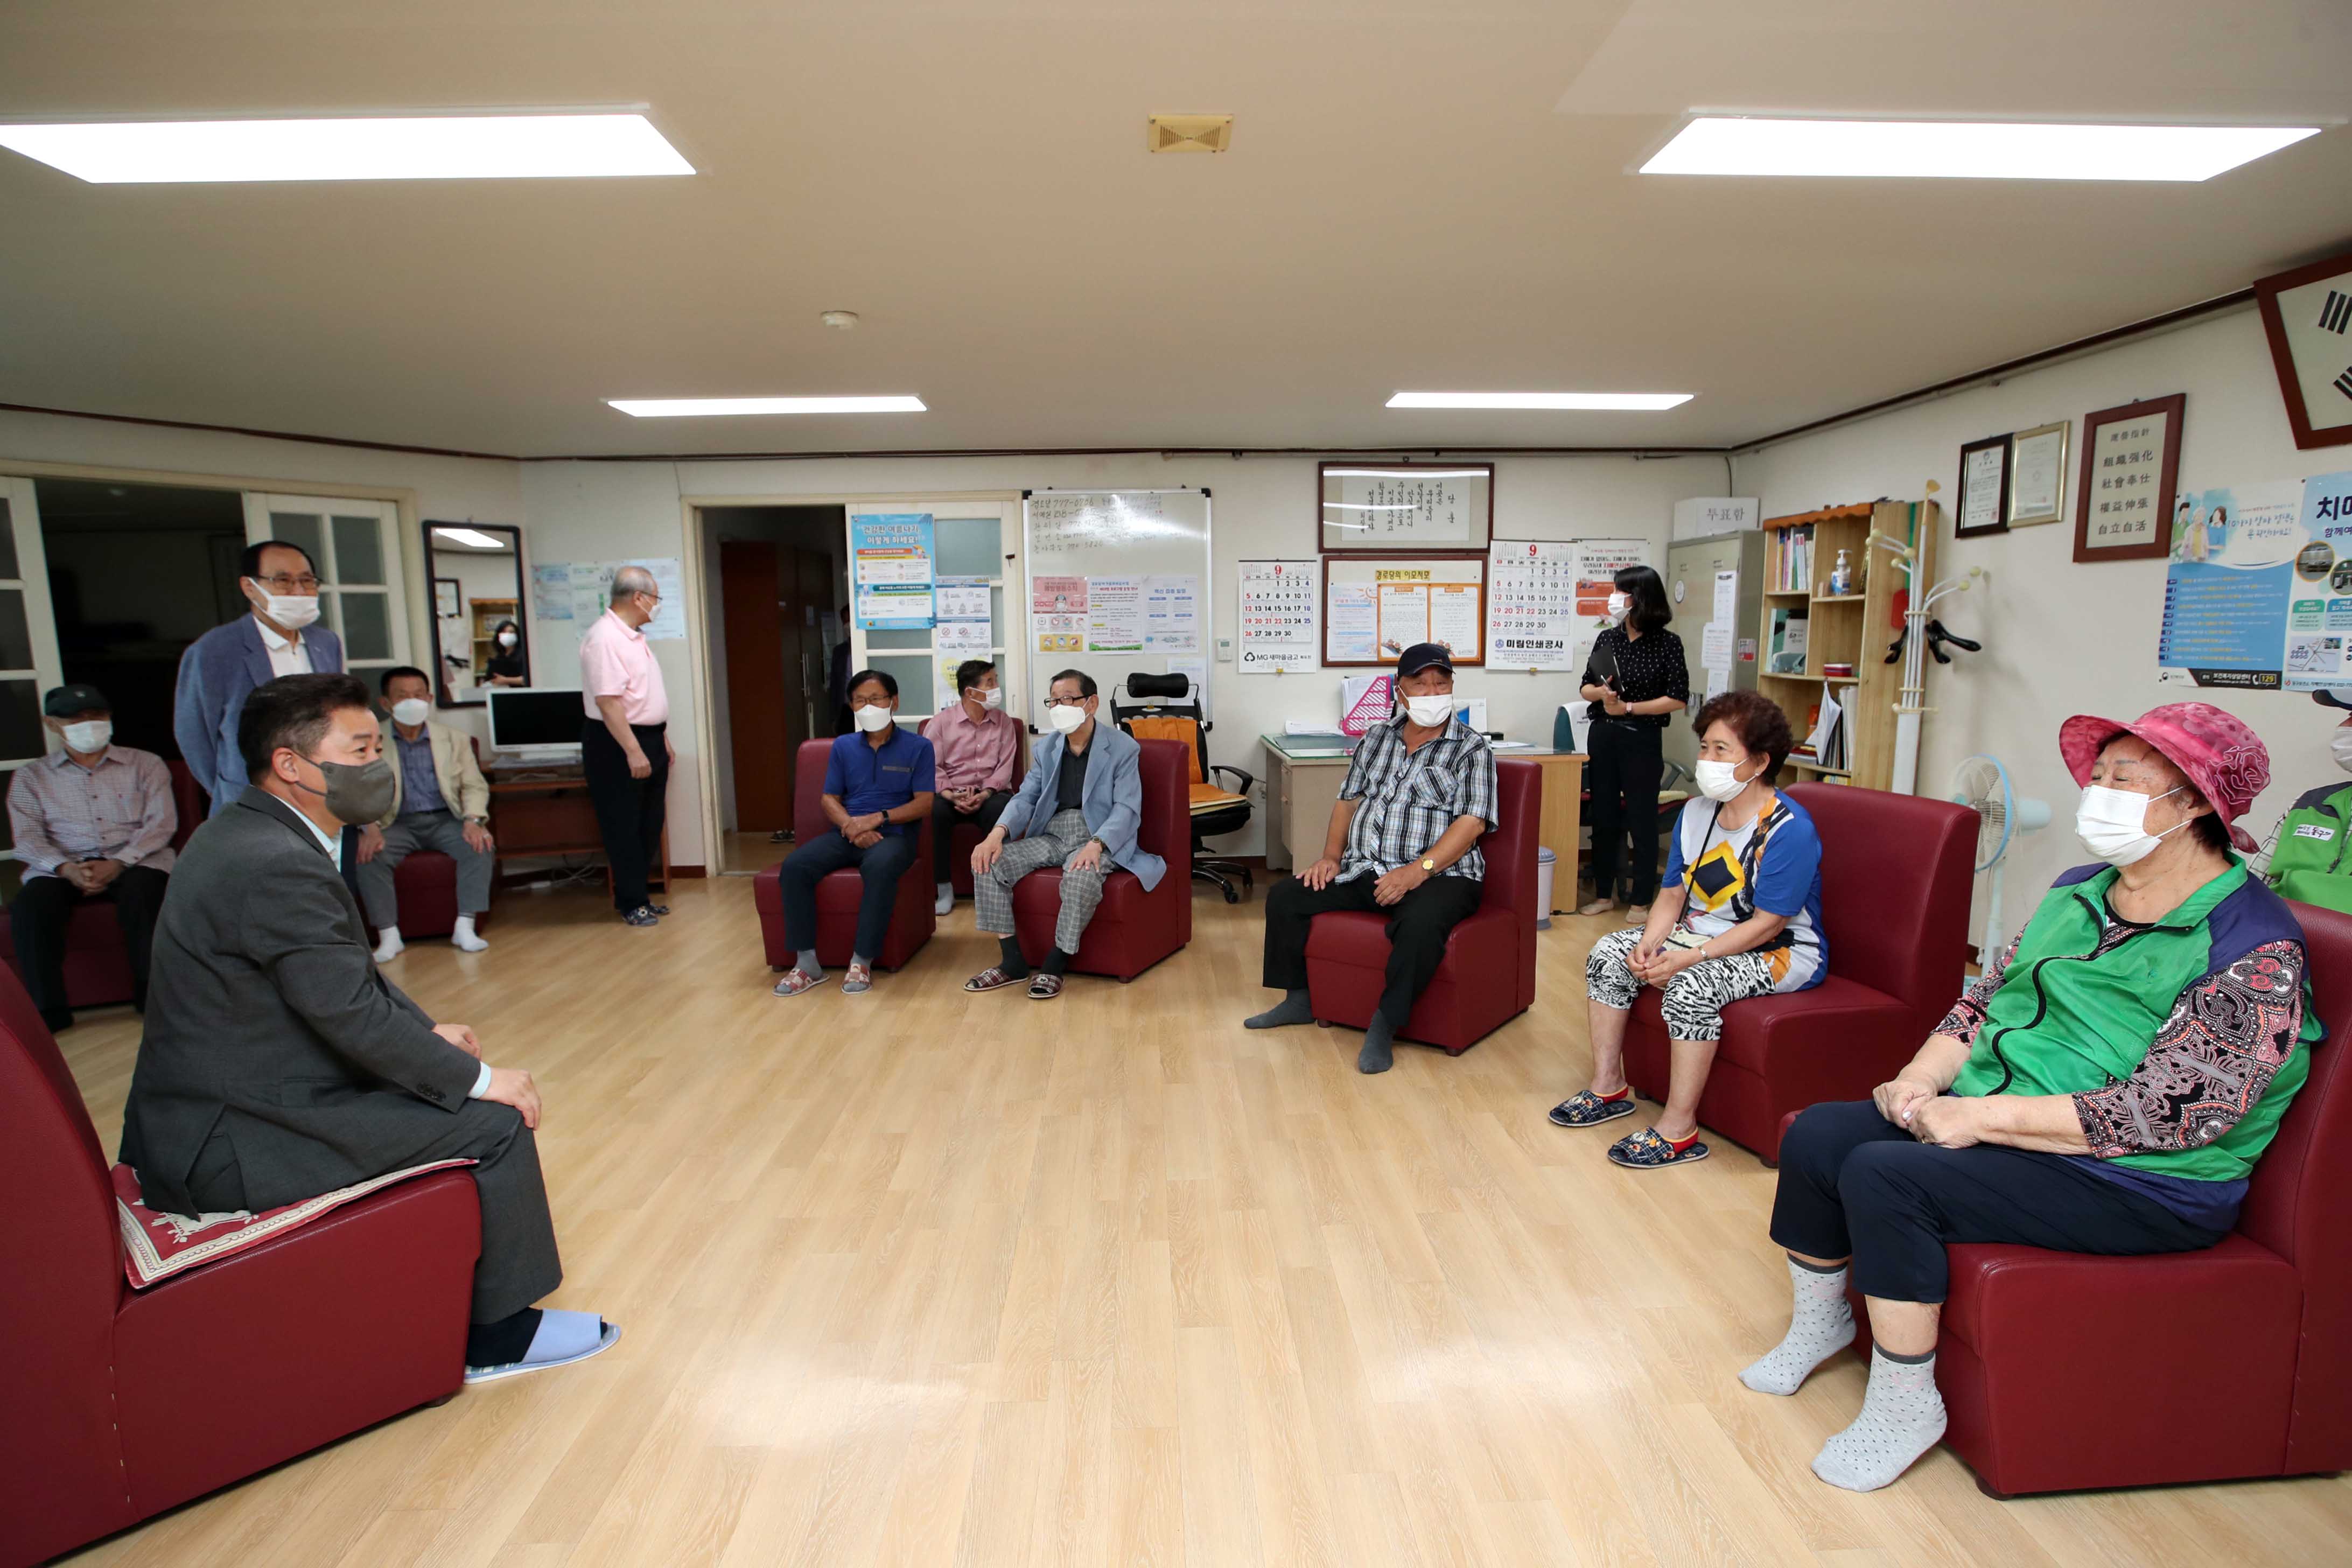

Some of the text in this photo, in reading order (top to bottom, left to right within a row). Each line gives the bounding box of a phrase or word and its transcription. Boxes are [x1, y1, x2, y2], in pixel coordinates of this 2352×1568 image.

[863, 525, 885, 534] 건강한
[2099, 519, 2147, 535] 自立自活
[867, 535, 890, 544] 이렇게
[1529, 544, 1537, 556] 9
[1275, 565, 1282, 575] 9
[1376, 570, 1430, 580] 경로당의 이모저모
[1507, 639, 1563, 649] 미림인쇄공사
